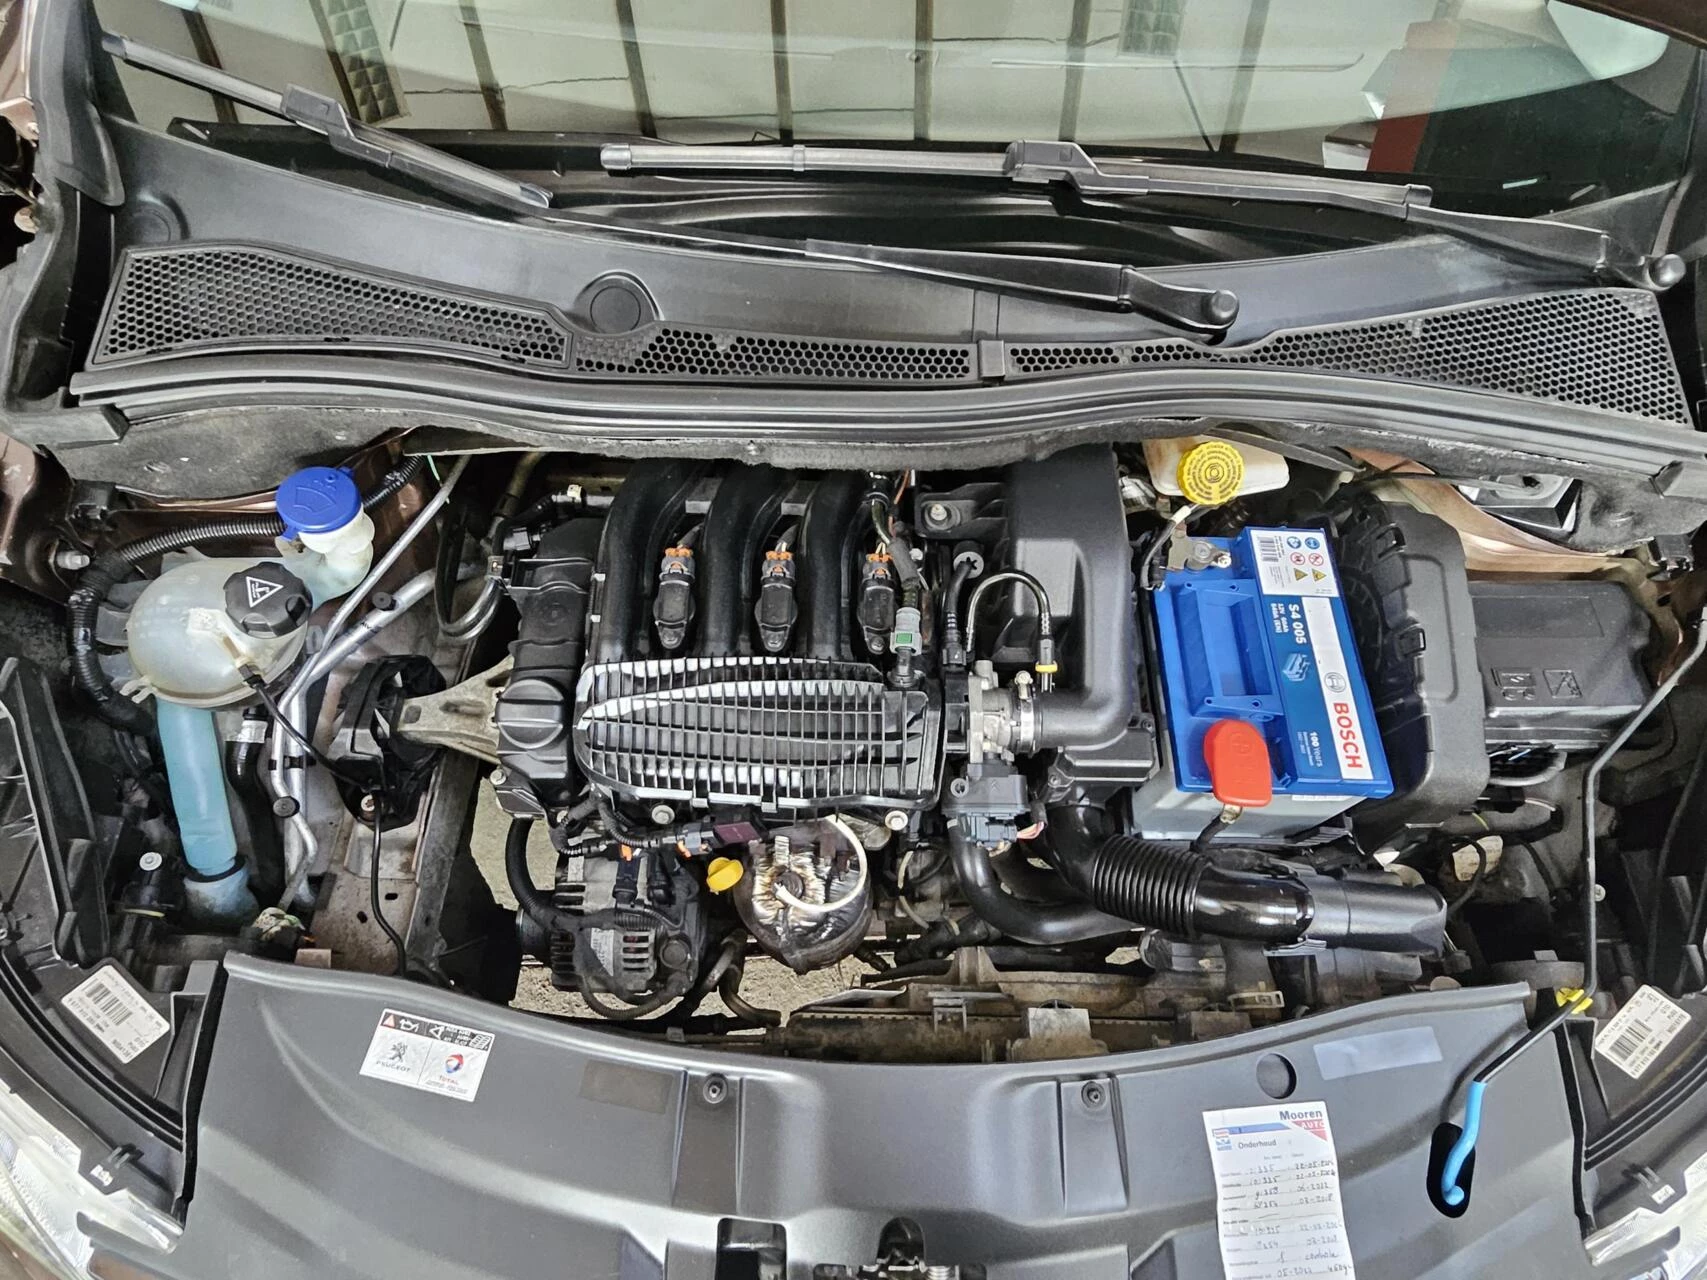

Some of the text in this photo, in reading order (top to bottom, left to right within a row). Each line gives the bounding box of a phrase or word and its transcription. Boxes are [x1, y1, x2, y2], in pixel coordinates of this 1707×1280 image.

[1288, 603, 1308, 645] S4 005
[1309, 731, 1320, 748] 100
[1333, 702, 1363, 769] BOSCH
[1279, 1110, 1323, 1121] Mooren
[1238, 1139, 1277, 1149] Onderhoud
